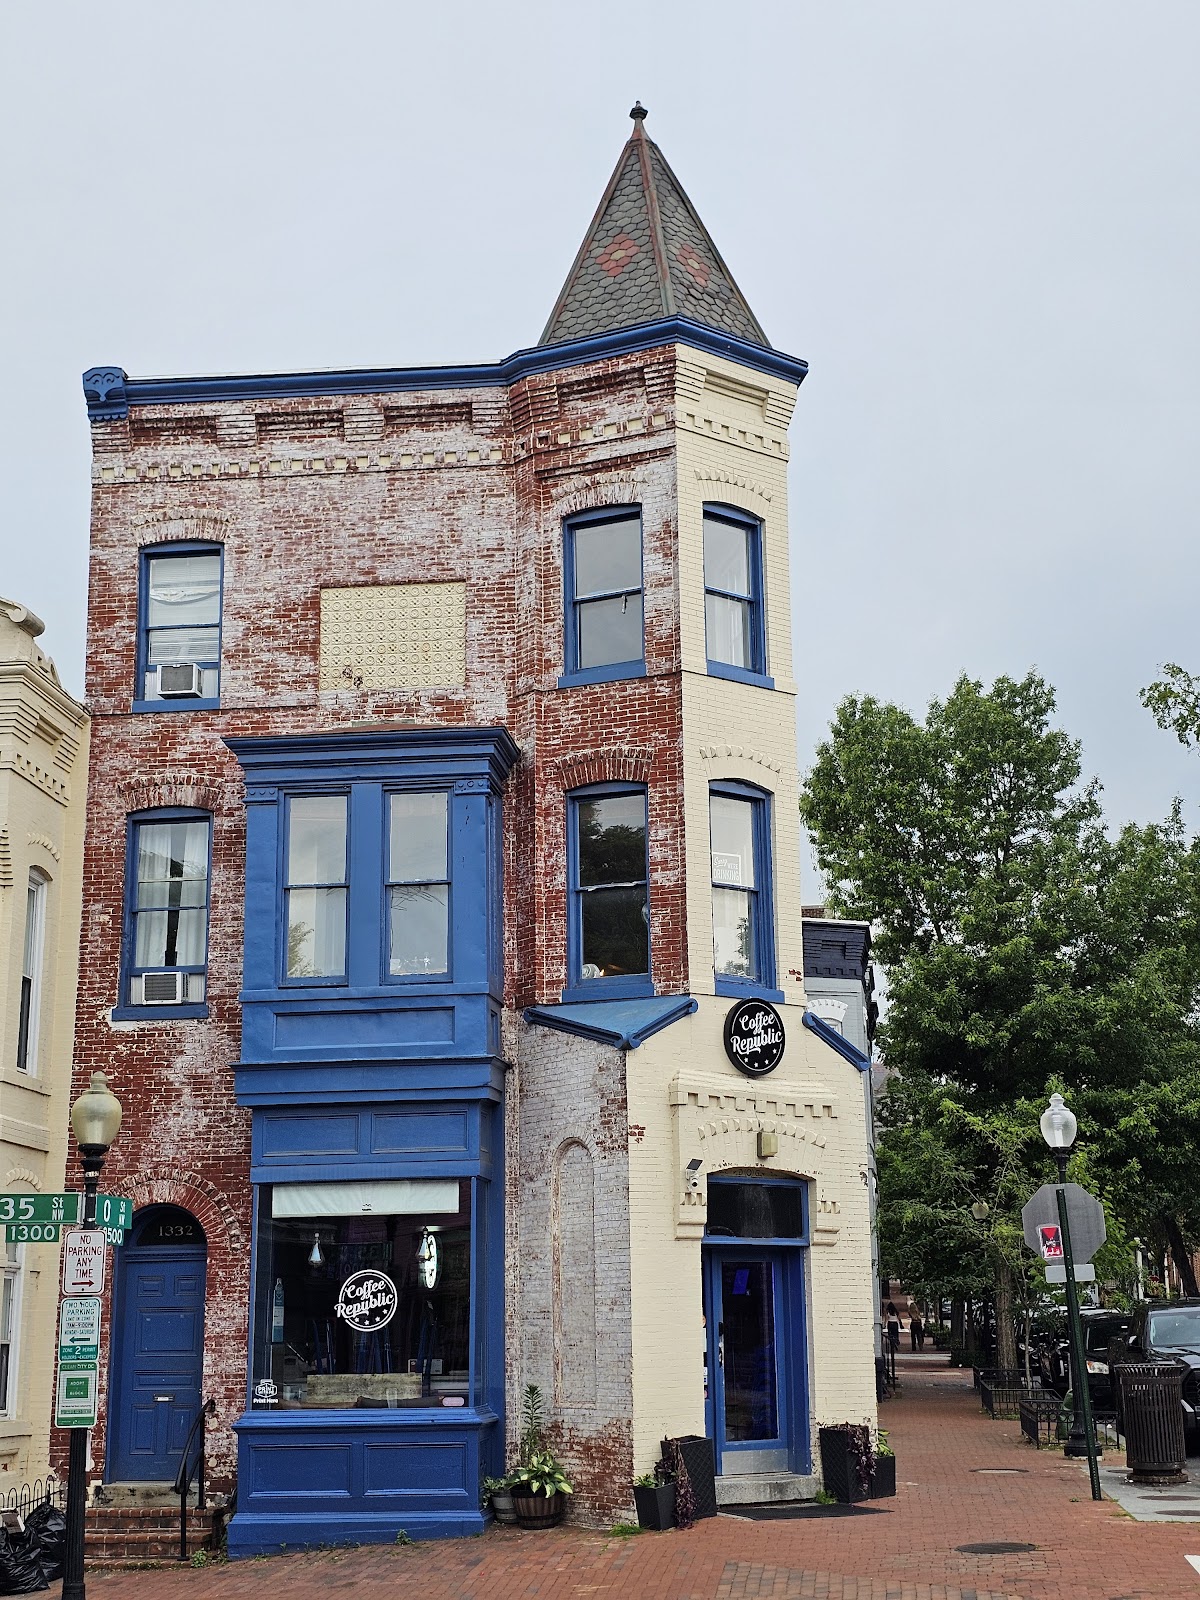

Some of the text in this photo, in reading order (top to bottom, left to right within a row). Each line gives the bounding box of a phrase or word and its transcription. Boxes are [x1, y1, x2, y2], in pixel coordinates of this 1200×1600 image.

[713, 869, 739, 880] DRINKING
[739, 1011, 776, 1035] Coffee
[730, 1028, 783, 1055] Republic
[0, 1197, 64, 1220] 35 St
[119, 1201, 126, 1213] St
[52, 1209, 64, 1220] NW
[11, 1226, 55, 1241] 1300
[159, 1225, 193, 1237] 1332
[80, 1235, 91, 1244] NO
[68, 1246, 102, 1256] PARKING
[76, 1258, 92, 1267] ANY
[75, 1269, 93, 1278] TIME
[345, 1280, 386, 1300] Coffee
[334, 1292, 394, 1318] Republic
[75, 1346, 81, 1355] 2
